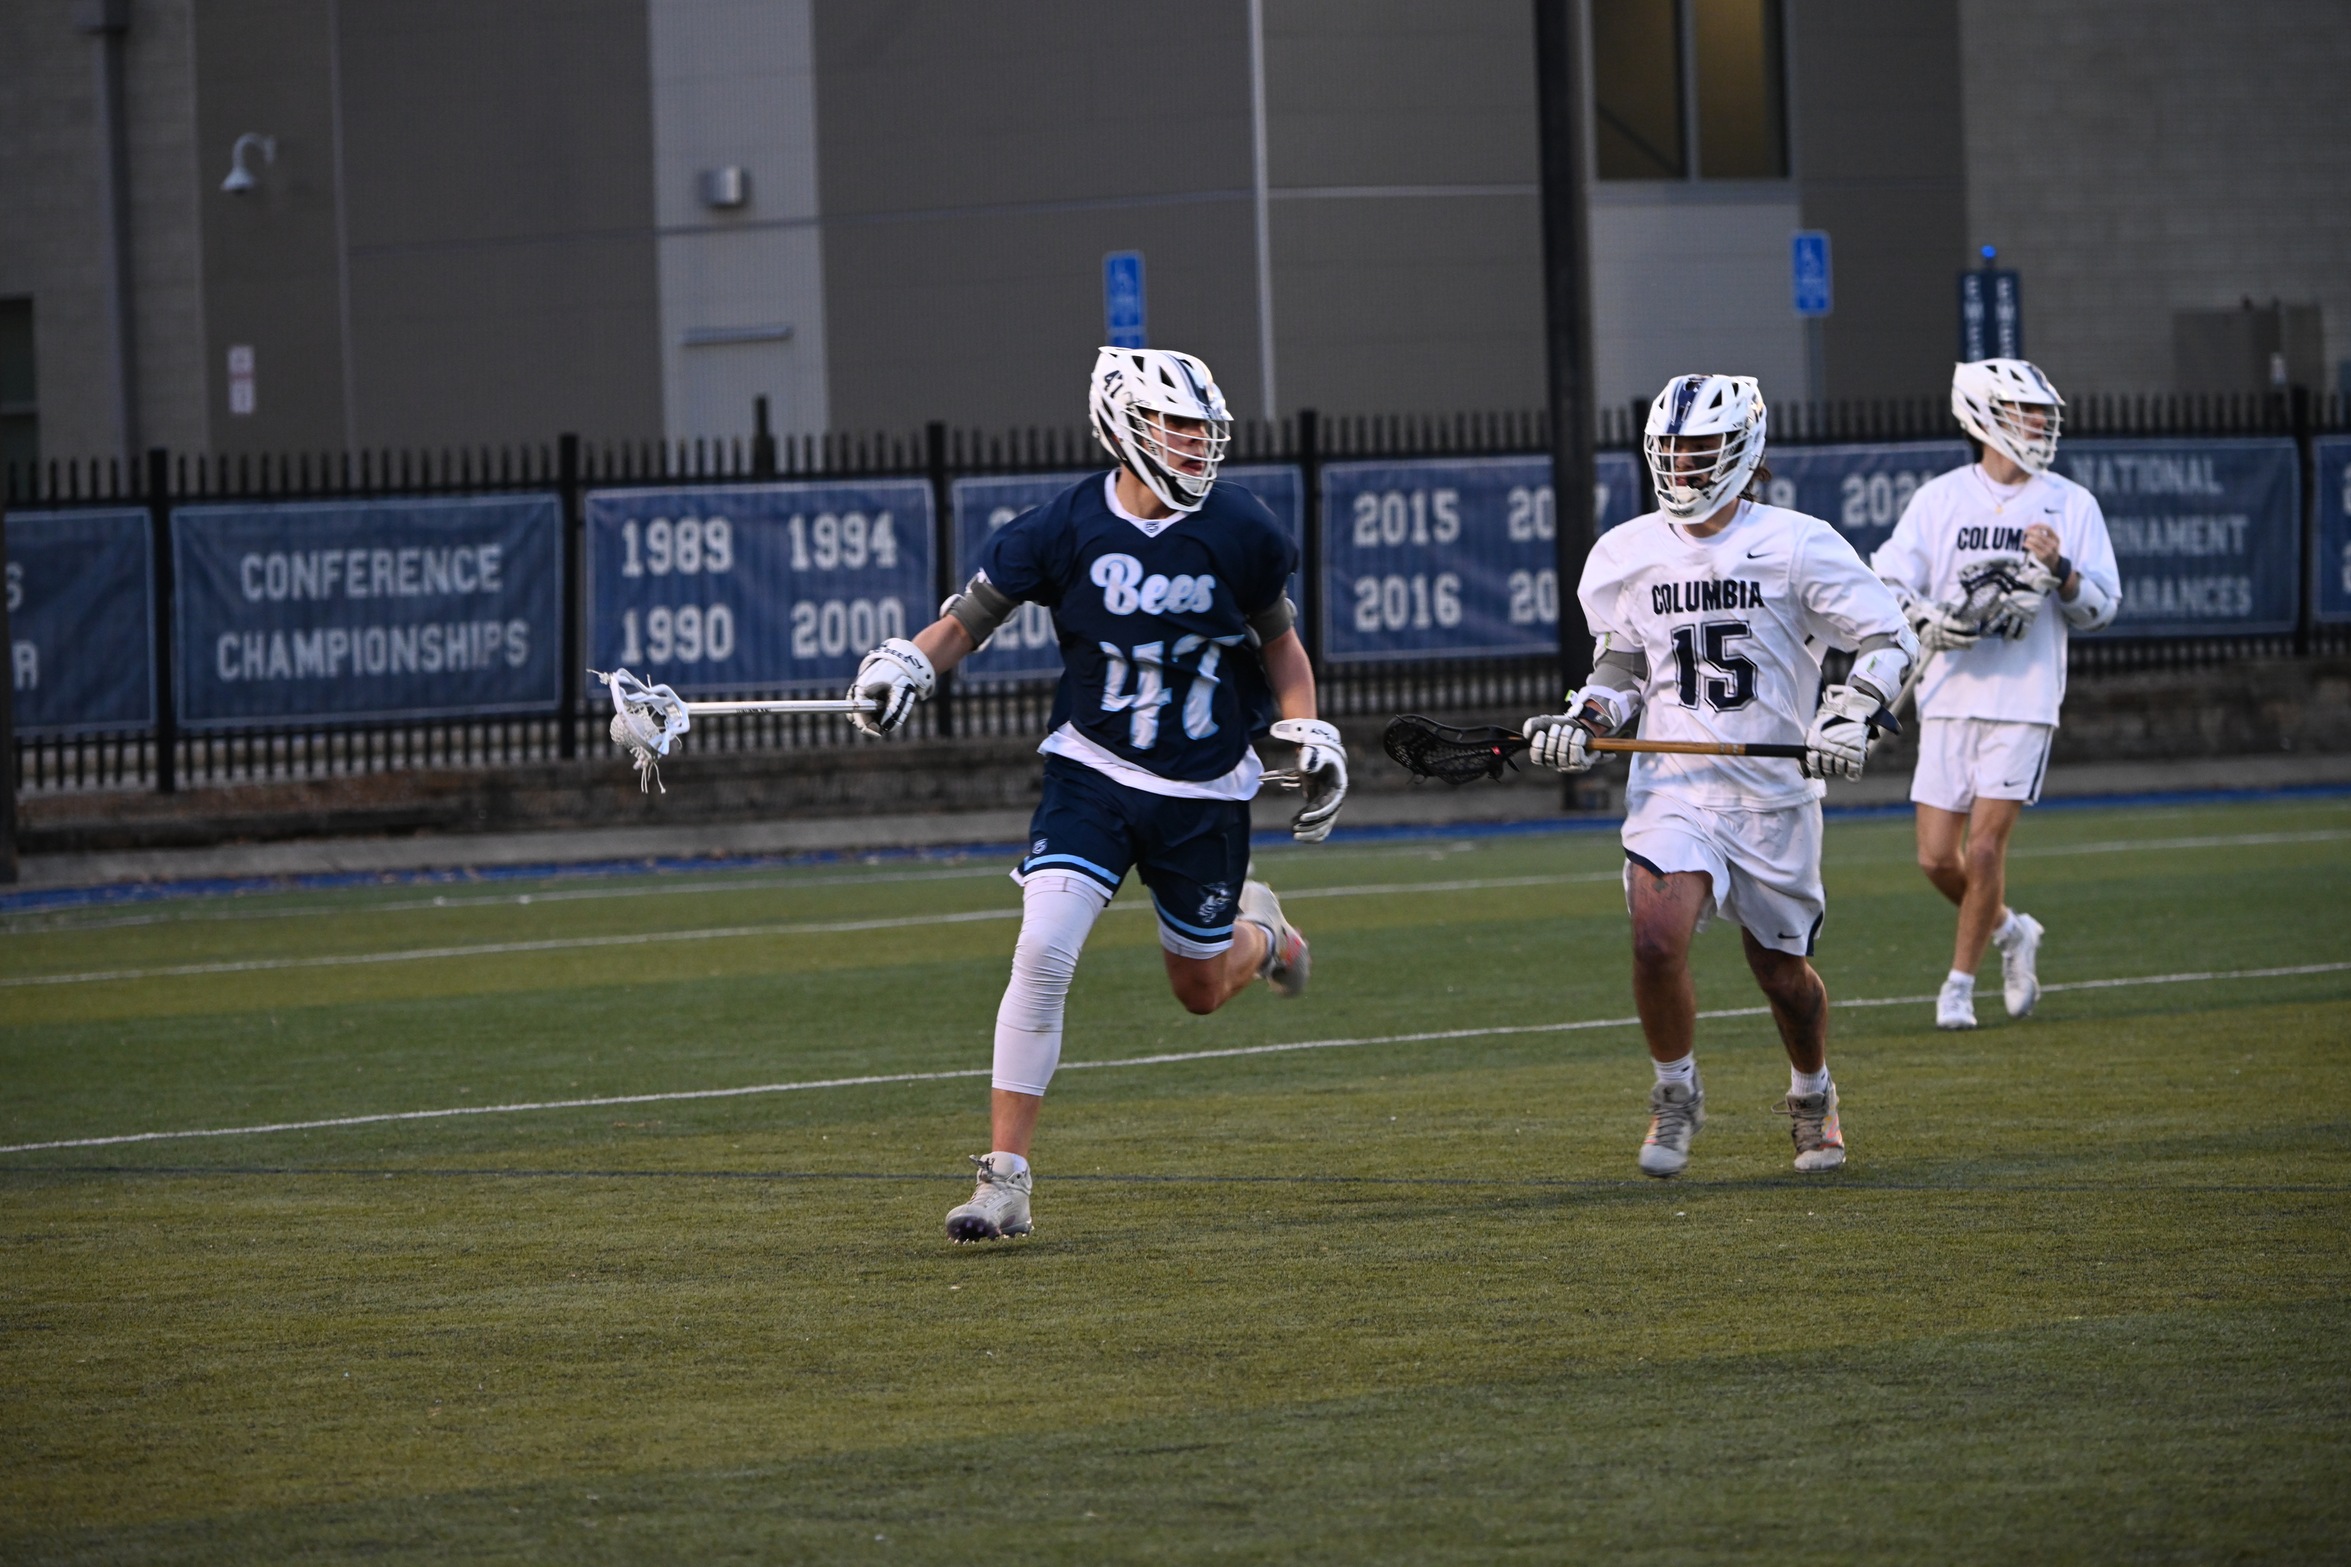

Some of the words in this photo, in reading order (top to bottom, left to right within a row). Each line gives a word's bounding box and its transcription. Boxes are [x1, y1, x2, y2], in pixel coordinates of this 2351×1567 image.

[2068, 454, 2224, 495] NATIONAL
[620, 516, 735, 578] 1989
[788, 511, 898, 572] 1994
[1352, 486, 1461, 547] 2015
[1957, 526, 2029, 552] COLUM
[240, 544, 504, 602] CONFERENCE
[1090, 552, 1216, 616] Bees
[1353, 571, 1463, 633] 2016
[1651, 579, 1766, 616] COLUMBIA
[216, 618, 531, 682] CHAMPIONSHIPS
[620, 604, 735, 667] 1990
[790, 598, 907, 659] 2000
[1099, 632, 1247, 751] 47
[1671, 619, 1759, 713] 15
